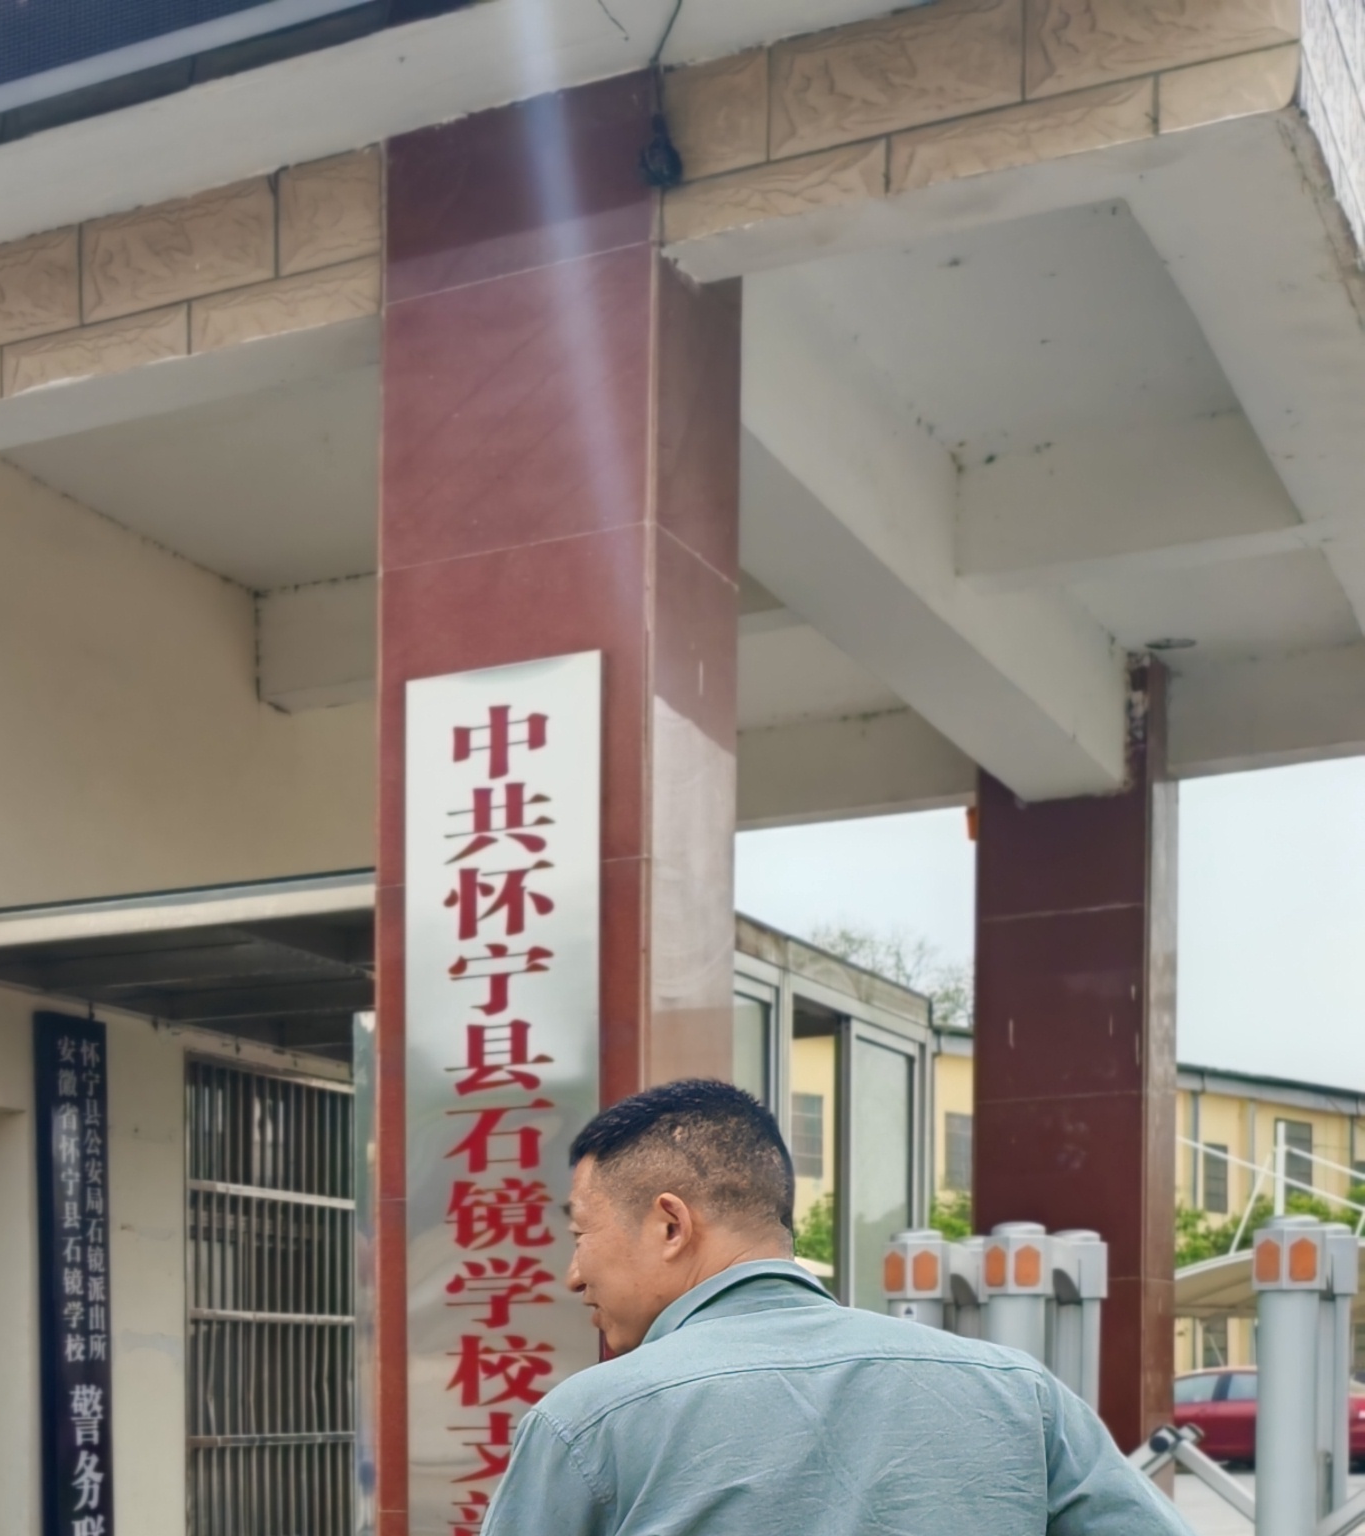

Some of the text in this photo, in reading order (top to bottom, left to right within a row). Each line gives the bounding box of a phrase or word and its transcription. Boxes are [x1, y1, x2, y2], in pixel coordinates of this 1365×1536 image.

[57, 1035, 86, 1362] 安徽省怀宁县石镜学校
[80, 1039, 108, 1361] 怀宁县公安局石镜派出所
